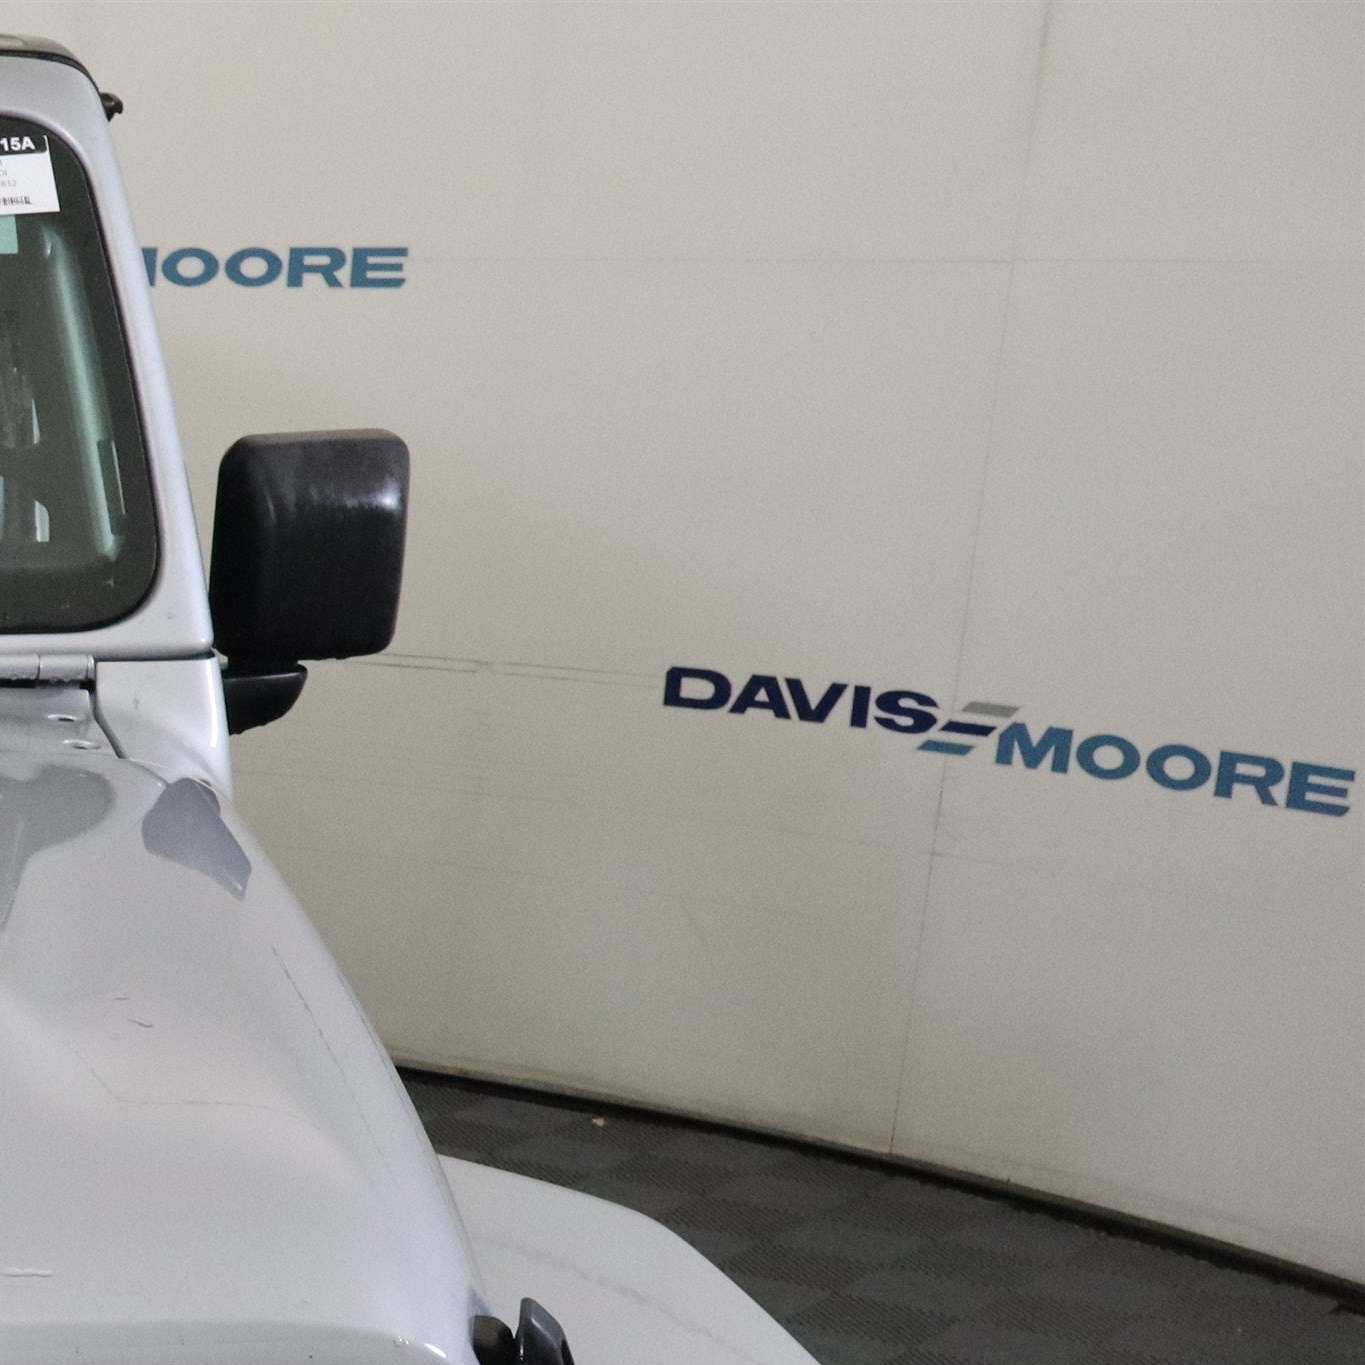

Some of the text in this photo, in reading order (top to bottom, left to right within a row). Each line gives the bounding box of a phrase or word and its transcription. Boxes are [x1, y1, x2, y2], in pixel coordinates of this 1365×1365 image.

[141, 247, 408, 288] OORE
[663, 666, 1357, 818] DAVIS MOORE
